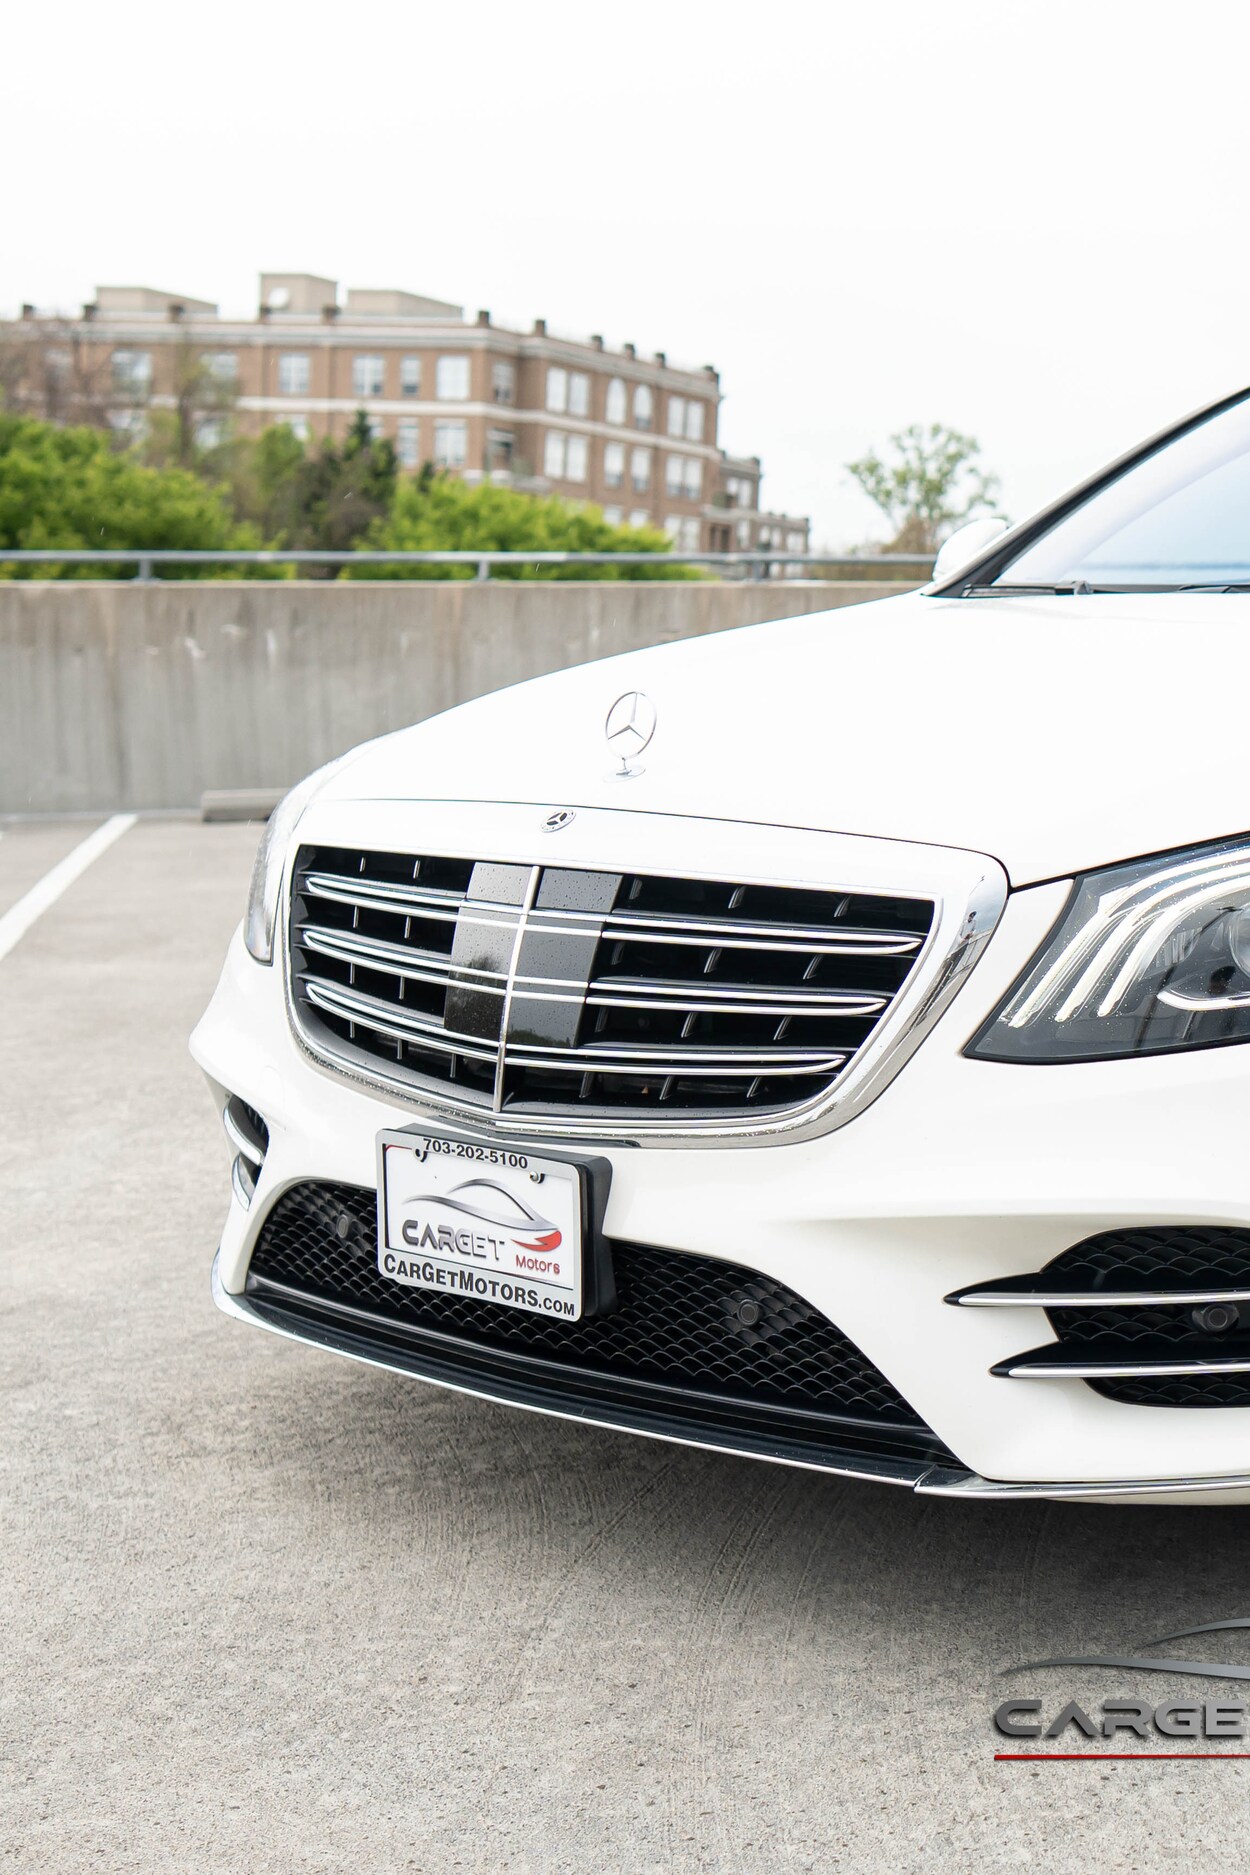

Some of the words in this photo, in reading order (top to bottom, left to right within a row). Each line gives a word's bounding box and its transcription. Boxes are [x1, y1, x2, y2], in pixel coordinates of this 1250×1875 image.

[423, 1138, 528, 1169] 703-202-5100
[401, 1219, 506, 1261] CARGET
[515, 1254, 561, 1275] Motors
